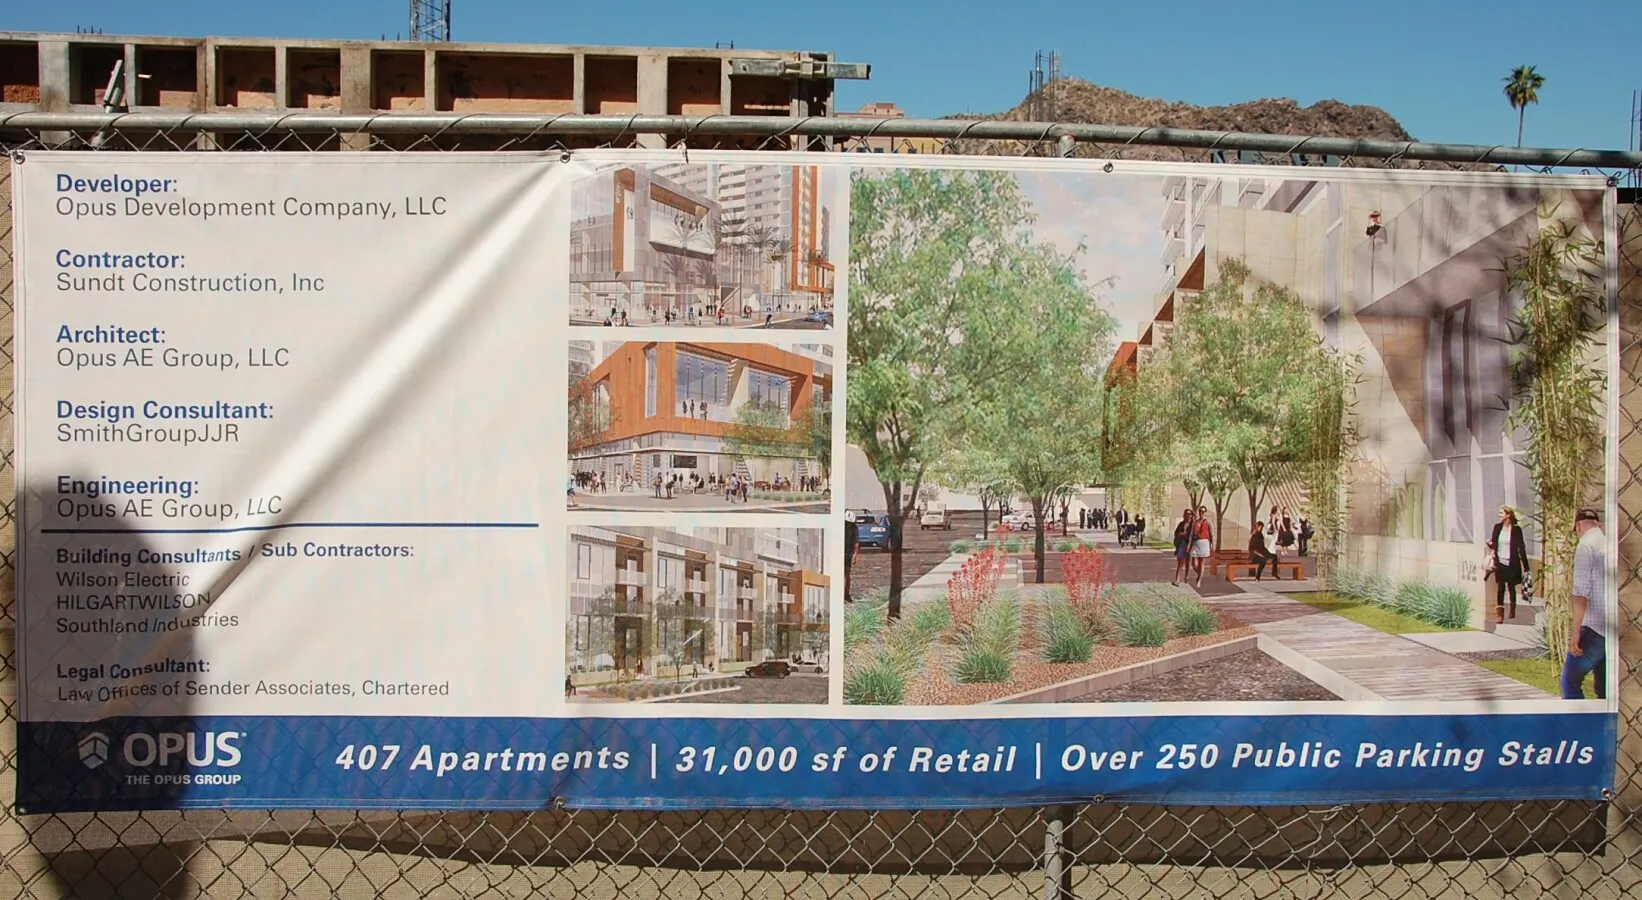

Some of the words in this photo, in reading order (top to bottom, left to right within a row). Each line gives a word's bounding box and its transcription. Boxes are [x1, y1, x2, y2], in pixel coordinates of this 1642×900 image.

[56, 174, 178, 197] Developer:
[56, 198, 117, 219] Opus
[125, 197, 276, 219] Development
[283, 197, 397, 219] Company,
[405, 196, 447, 216] LLC
[56, 249, 186, 269] Contractor:
[57, 272, 126, 292] Sundt
[132, 272, 284, 295] Construction,
[292, 273, 325, 292] Inc
[57, 325, 166, 344] Architect:
[57, 348, 117, 369] Opus
[123, 348, 154, 368] AE
[163, 348, 241, 369] Group,
[248, 348, 290, 367] LLC
[57, 400, 135, 424] Design
[143, 400, 275, 419] Consultant:
[57, 423, 240, 446] SmithGroupJJR
[57, 475, 199, 498] Engineering:
[57, 499, 116, 521] Opus
[122, 499, 153, 517] AE
[162, 498, 239, 521] Group,
[247, 495, 282, 516] LLC
[56, 548, 131, 567] Building
[137, 548, 241, 564] Consultants
[261, 542, 298, 557] Sub
[303, 541, 415, 557] Contractors:
[56, 572, 118, 587] Wilson
[125, 570, 190, 587] Electric
[57, 592, 212, 610] HILGARTWILSON
[56, 617, 148, 633] Southland
[152, 612, 239, 633] Industries
[57, 663, 105, 682] Legal
[109, 657, 211, 679] Consultant:
[58, 686, 92, 702] Law
[98, 683, 157, 702] Offices
[162, 680, 180, 696] of
[185, 680, 251, 696] Sender
[255, 680, 356, 697] Associates,
[362, 679, 449, 696] Chartered
[123, 731, 242, 767] OPUS
[335, 745, 400, 770] 407
[409, 745, 630, 777] Apartments
[675, 746, 798, 776] 31,000
[812, 746, 847, 772] sf
[859, 746, 897, 772] of
[908, 746, 1016, 772] Retail
[1060, 744, 1144, 771] Over
[1155, 743, 1219, 770] 250
[1231, 742, 1341, 769] Public
[1355, 742, 1485, 772] Parking
[1498, 740, 1594, 767] Stalls
[126, 774, 151, 785] THE
[154, 774, 191, 785] OPUS
[194, 773, 242, 785] GROUP
